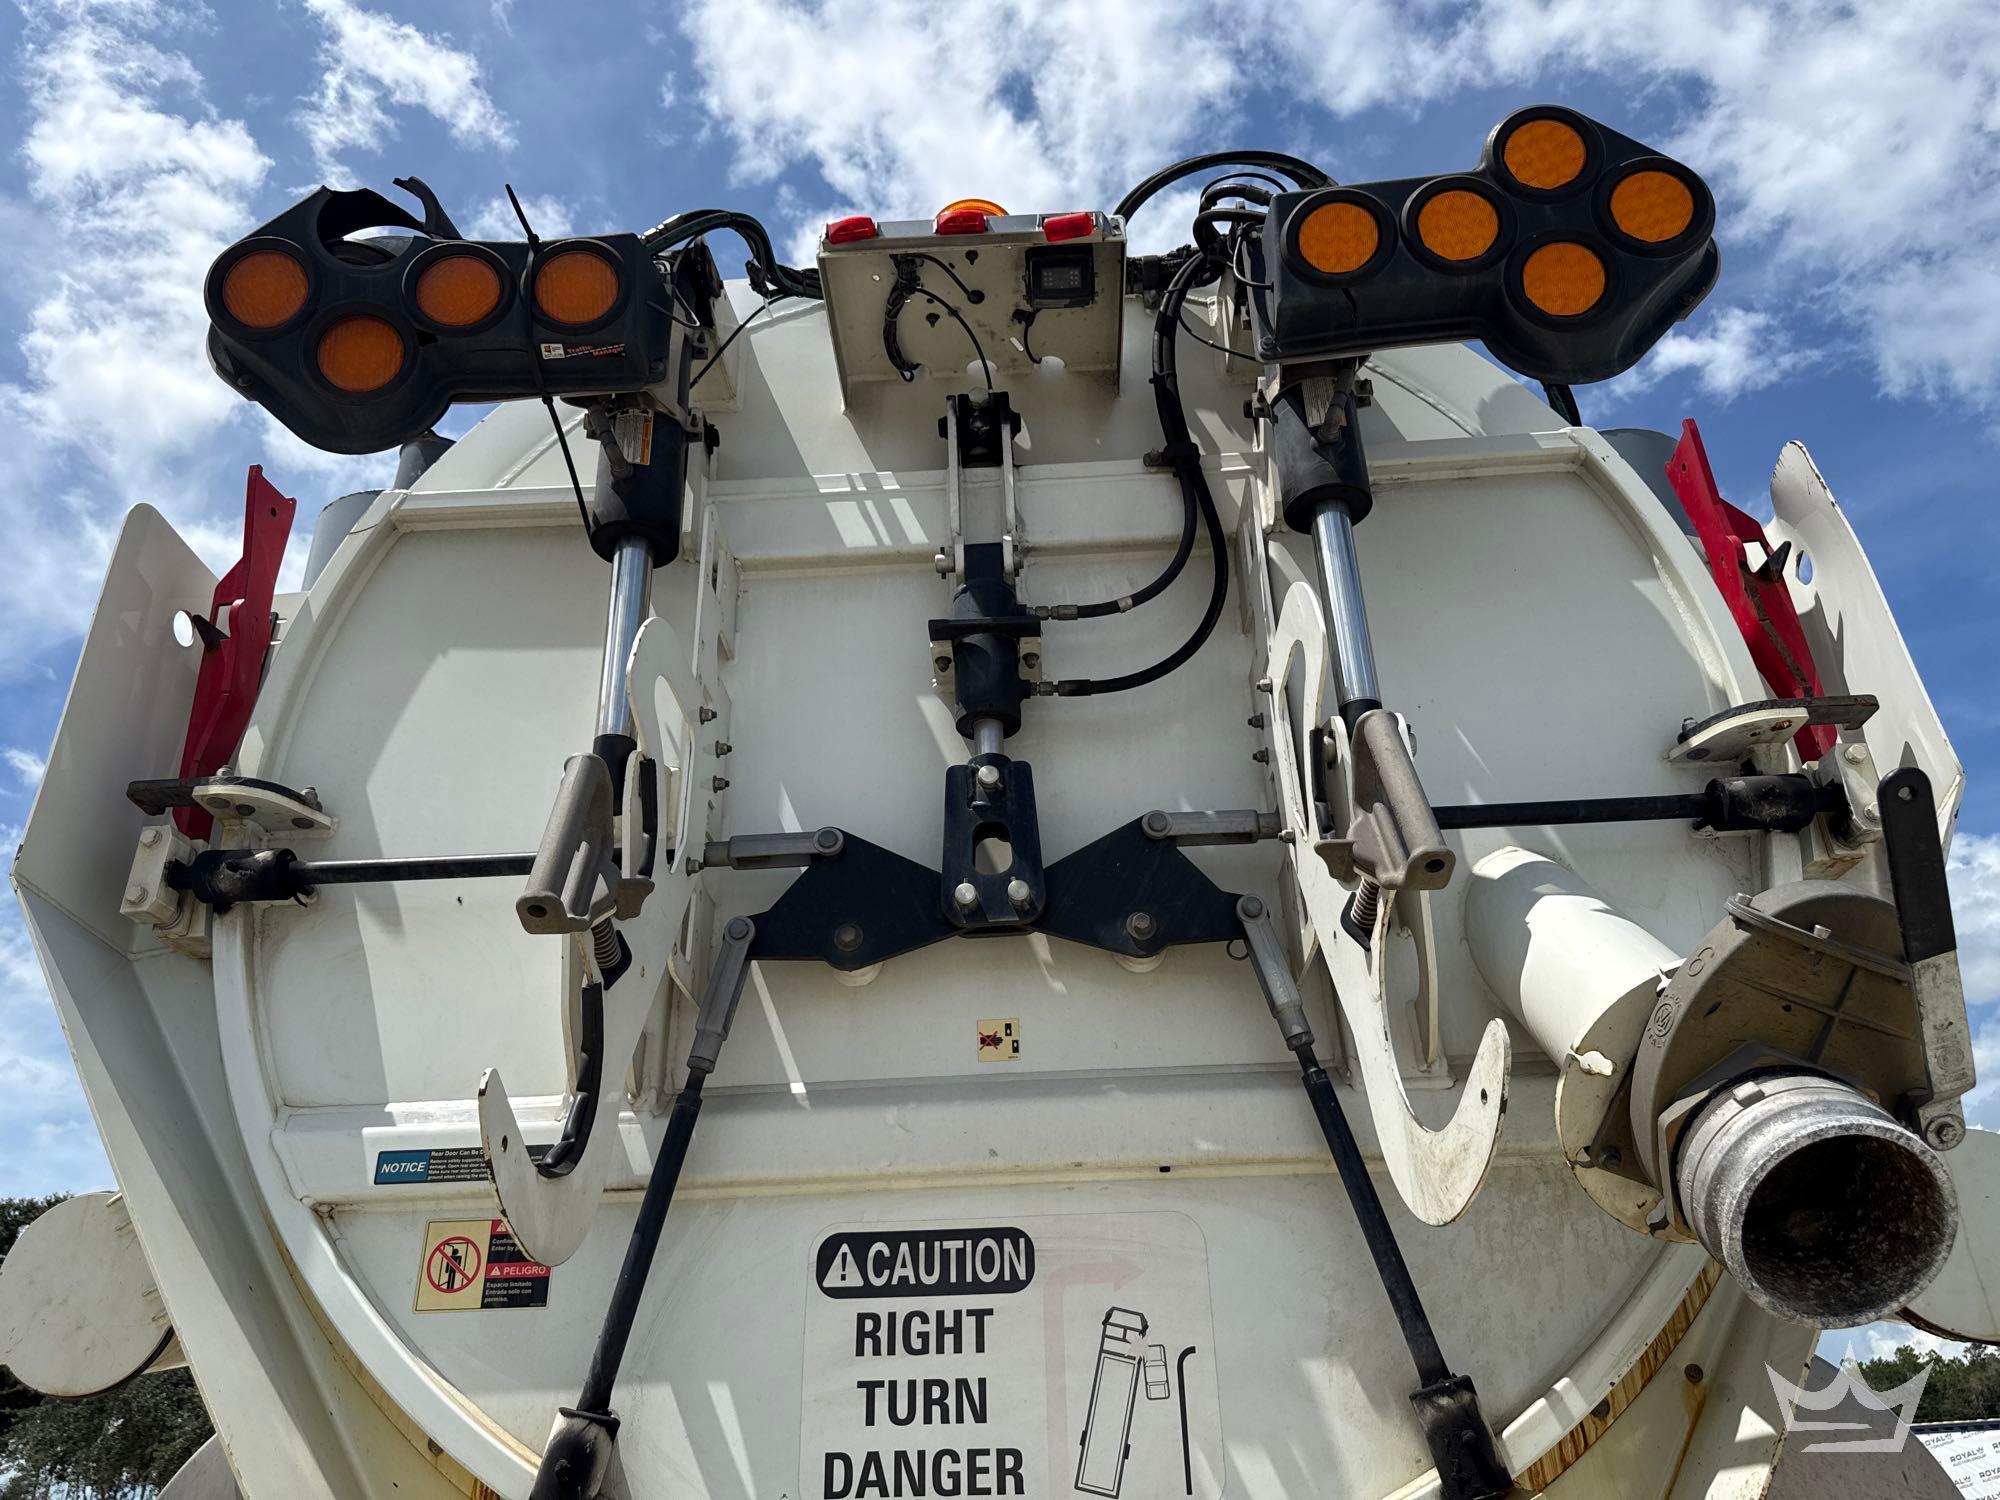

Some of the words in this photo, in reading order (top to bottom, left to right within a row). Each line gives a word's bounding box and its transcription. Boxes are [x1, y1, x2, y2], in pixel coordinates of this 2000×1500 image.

[381, 1161, 427, 1174] NOTICE
[503, 1266, 546, 1275] PELIGRO
[866, 1237, 1028, 1288] CAUTION
[854, 1307, 995, 1357] RIGHT
[857, 1377, 988, 1427] TURN
[1949, 1450, 1978, 1463] ROYAL
[823, 1448, 1026, 1500] DANGER
[1979, 1467, 2000, 1478] ROYA
